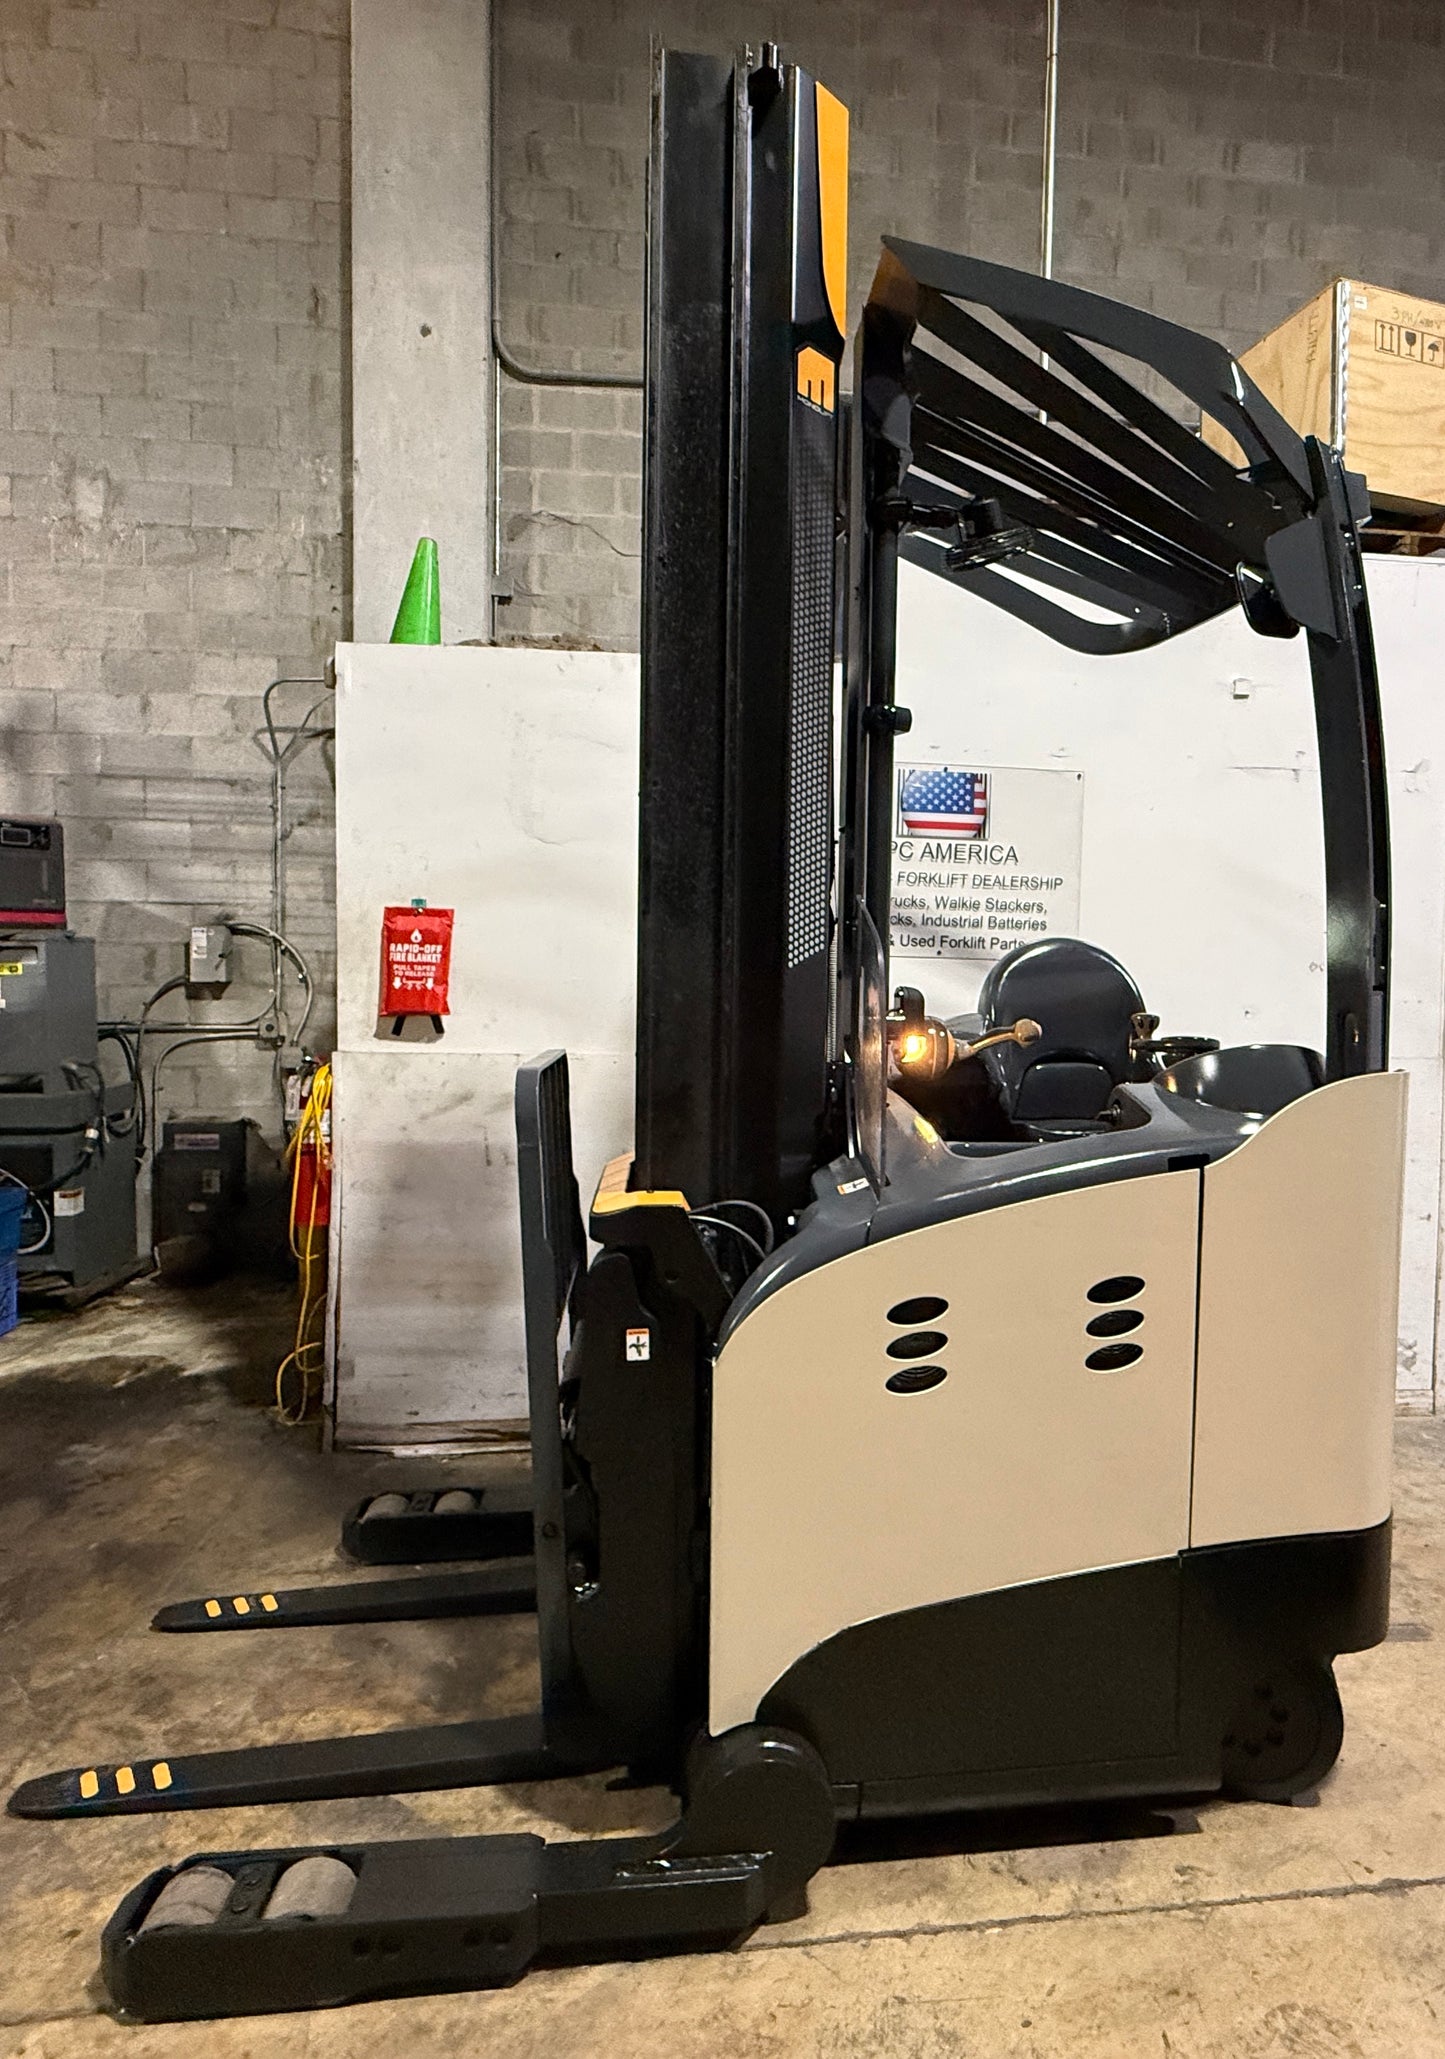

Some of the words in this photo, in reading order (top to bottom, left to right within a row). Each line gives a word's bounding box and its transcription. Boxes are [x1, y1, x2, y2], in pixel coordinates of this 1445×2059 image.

[920, 842, 1019, 863] AMERICA
[897, 871, 968, 888] FORKLIFT
[972, 875, 1064, 890] DEALERSHIP
[934, 896, 981, 911] Walkie
[985, 898, 1047, 914] Stackers,
[922, 912, 984, 928] Industrial
[988, 915, 1048, 931] Batteries
[389, 943, 442, 953] RAPID-OFF
[900, 934, 936, 948] Used
[940, 935, 986, 950] Forklift
[389, 953, 407, 962] FIRE
[407, 954, 442, 963] BLANKET
